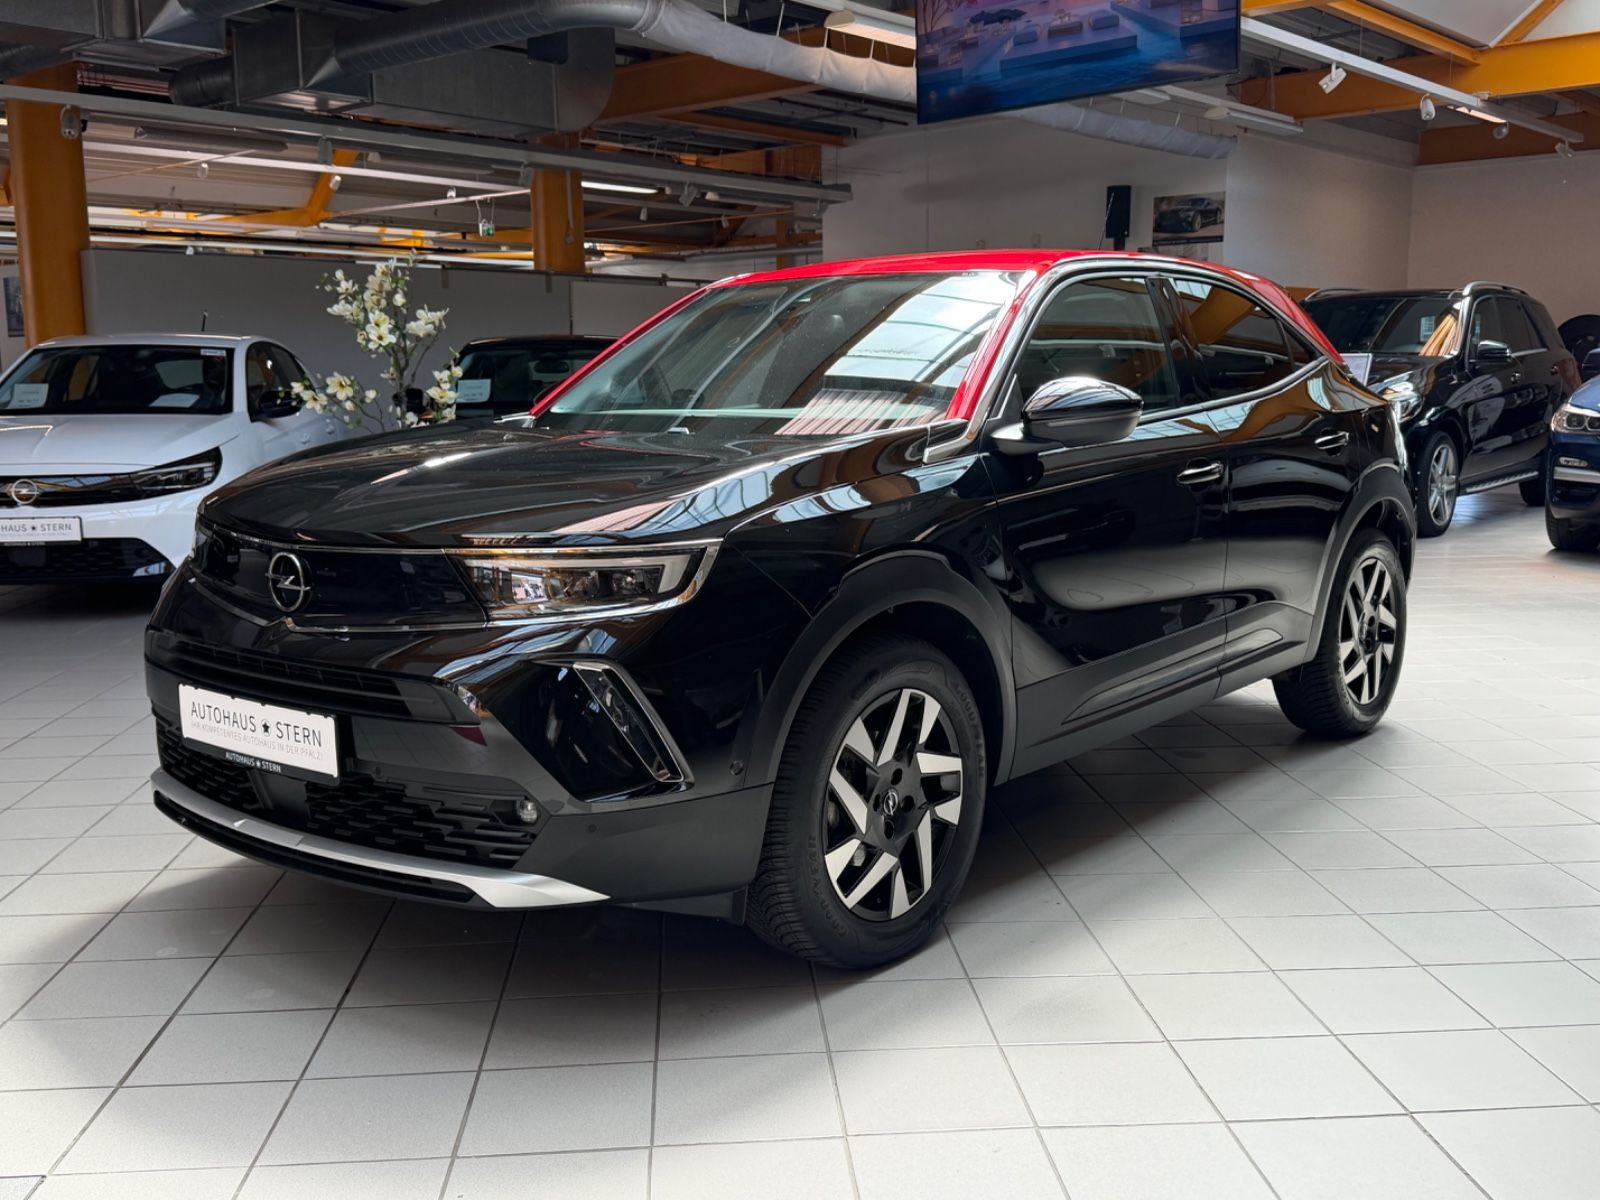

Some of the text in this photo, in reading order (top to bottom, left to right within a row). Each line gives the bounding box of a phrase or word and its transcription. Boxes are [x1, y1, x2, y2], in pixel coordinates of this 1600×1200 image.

[40, 523, 72, 532] STERN
[191, 701, 322, 748] AUTOHAUS STERN
[242, 734, 276, 750] AUTOHAUS
[225, 751, 282, 773] AUTOHAUS STERN
